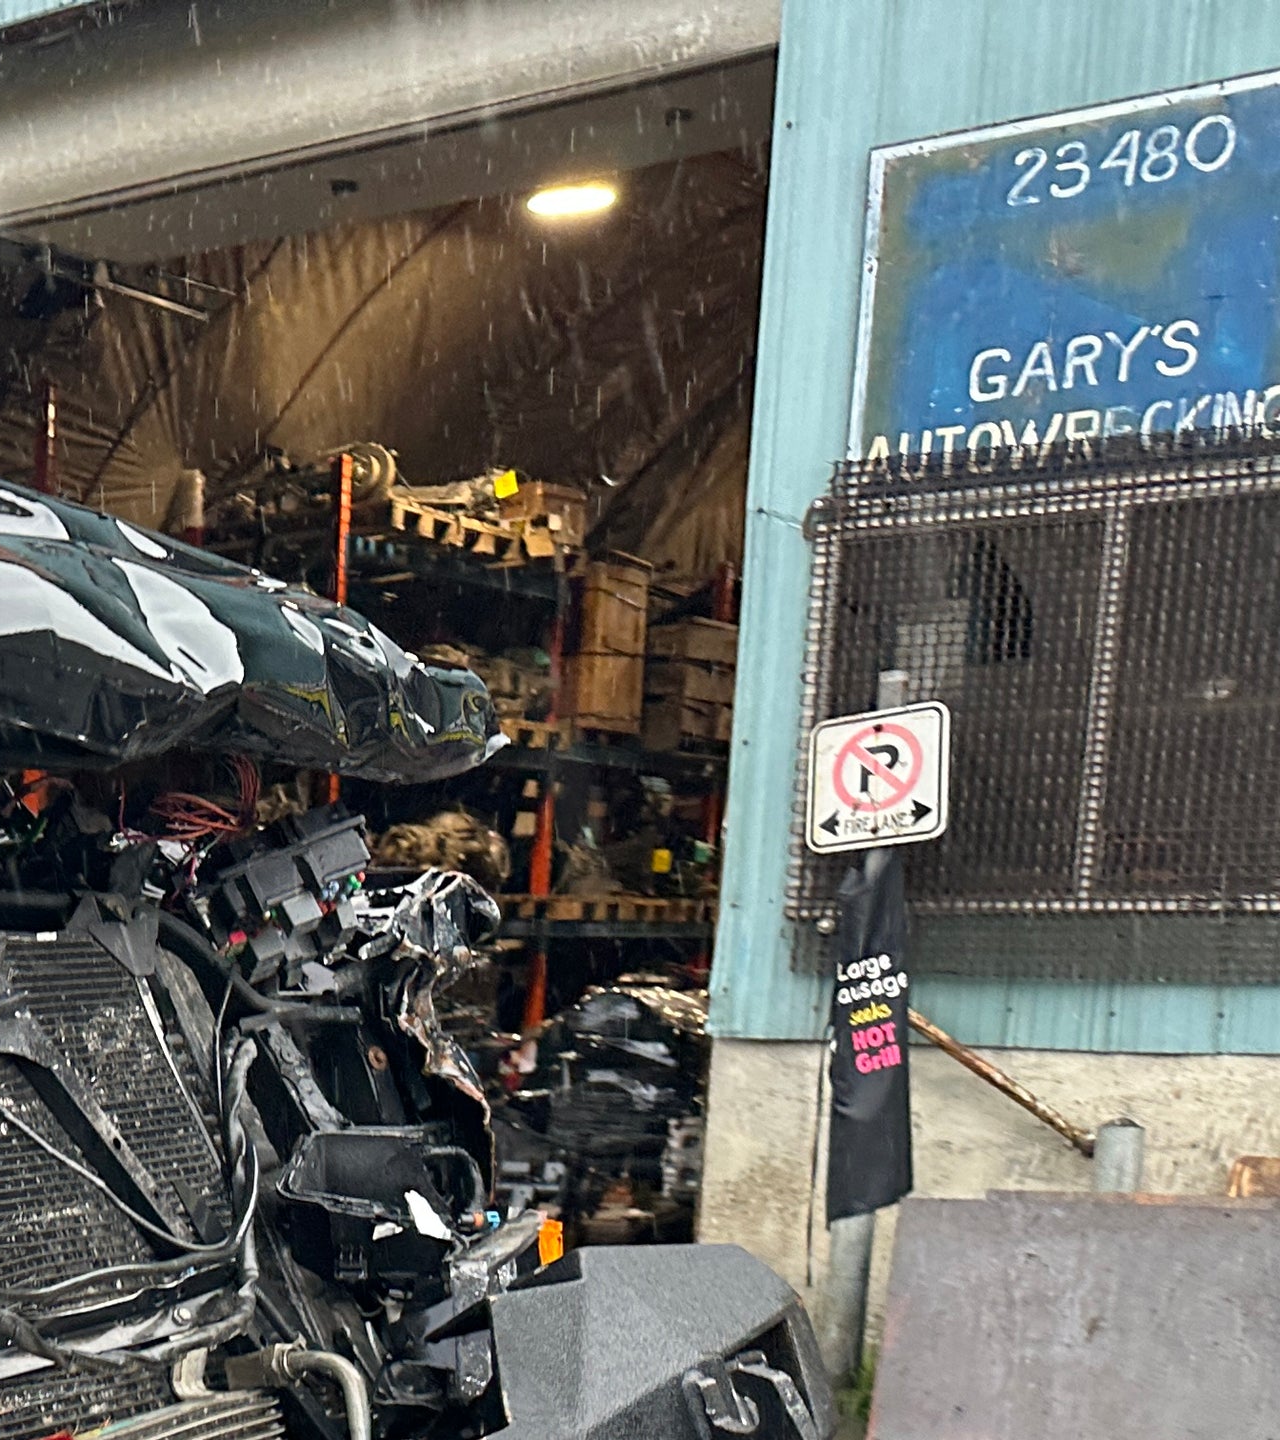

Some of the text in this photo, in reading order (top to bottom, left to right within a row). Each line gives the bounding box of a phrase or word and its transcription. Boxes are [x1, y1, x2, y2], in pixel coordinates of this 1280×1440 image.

[1007, 114, 1236, 207] 23480
[968, 319, 1200, 402] GARY'S
[836, 954, 892, 982] Large
[837, 971, 909, 1004] ausage
[851, 1021, 897, 1051] HOT
[855, 1044, 901, 1074] Grill
